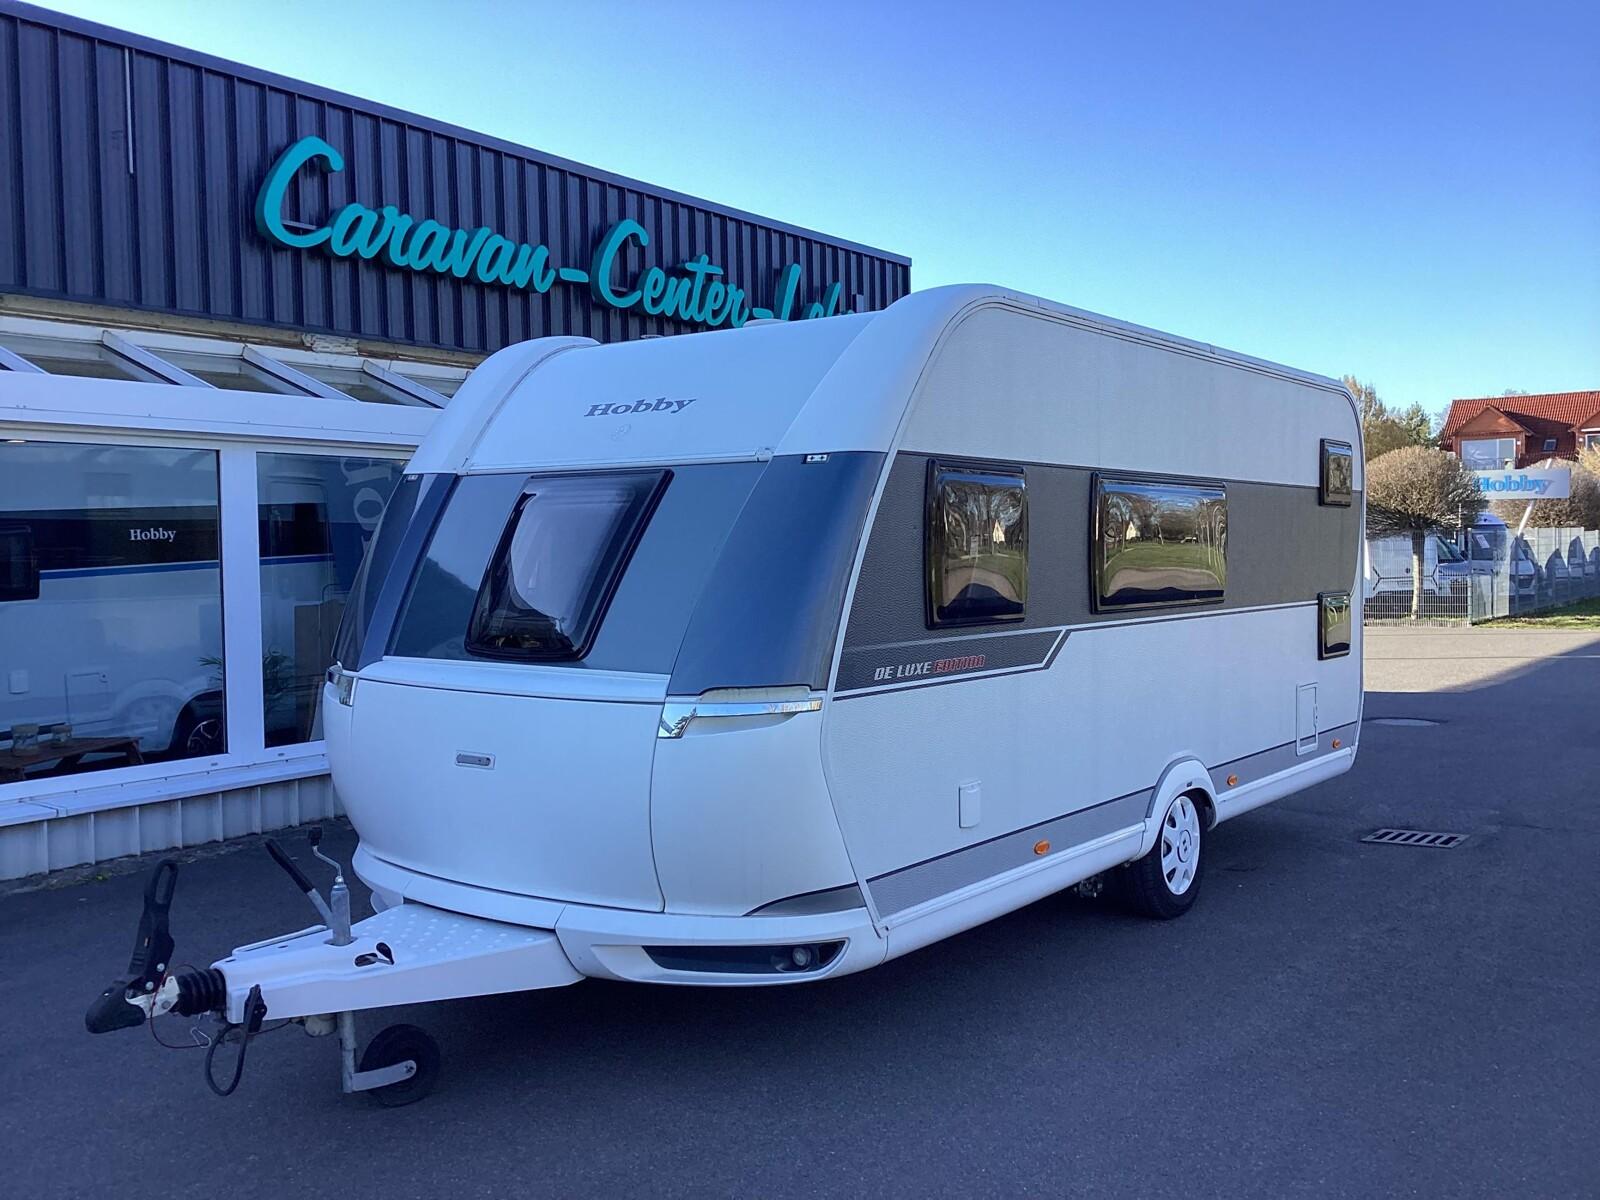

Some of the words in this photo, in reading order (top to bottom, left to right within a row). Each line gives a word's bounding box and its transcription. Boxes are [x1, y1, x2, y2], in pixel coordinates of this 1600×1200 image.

[584, 397, 697, 417] Hobby
[1473, 474, 1554, 495] Hobby
[129, 527, 177, 543] Hobby
[874, 666, 895, 681] DE
[896, 661, 932, 678] LUXE
[933, 654, 986, 674] EDITION
